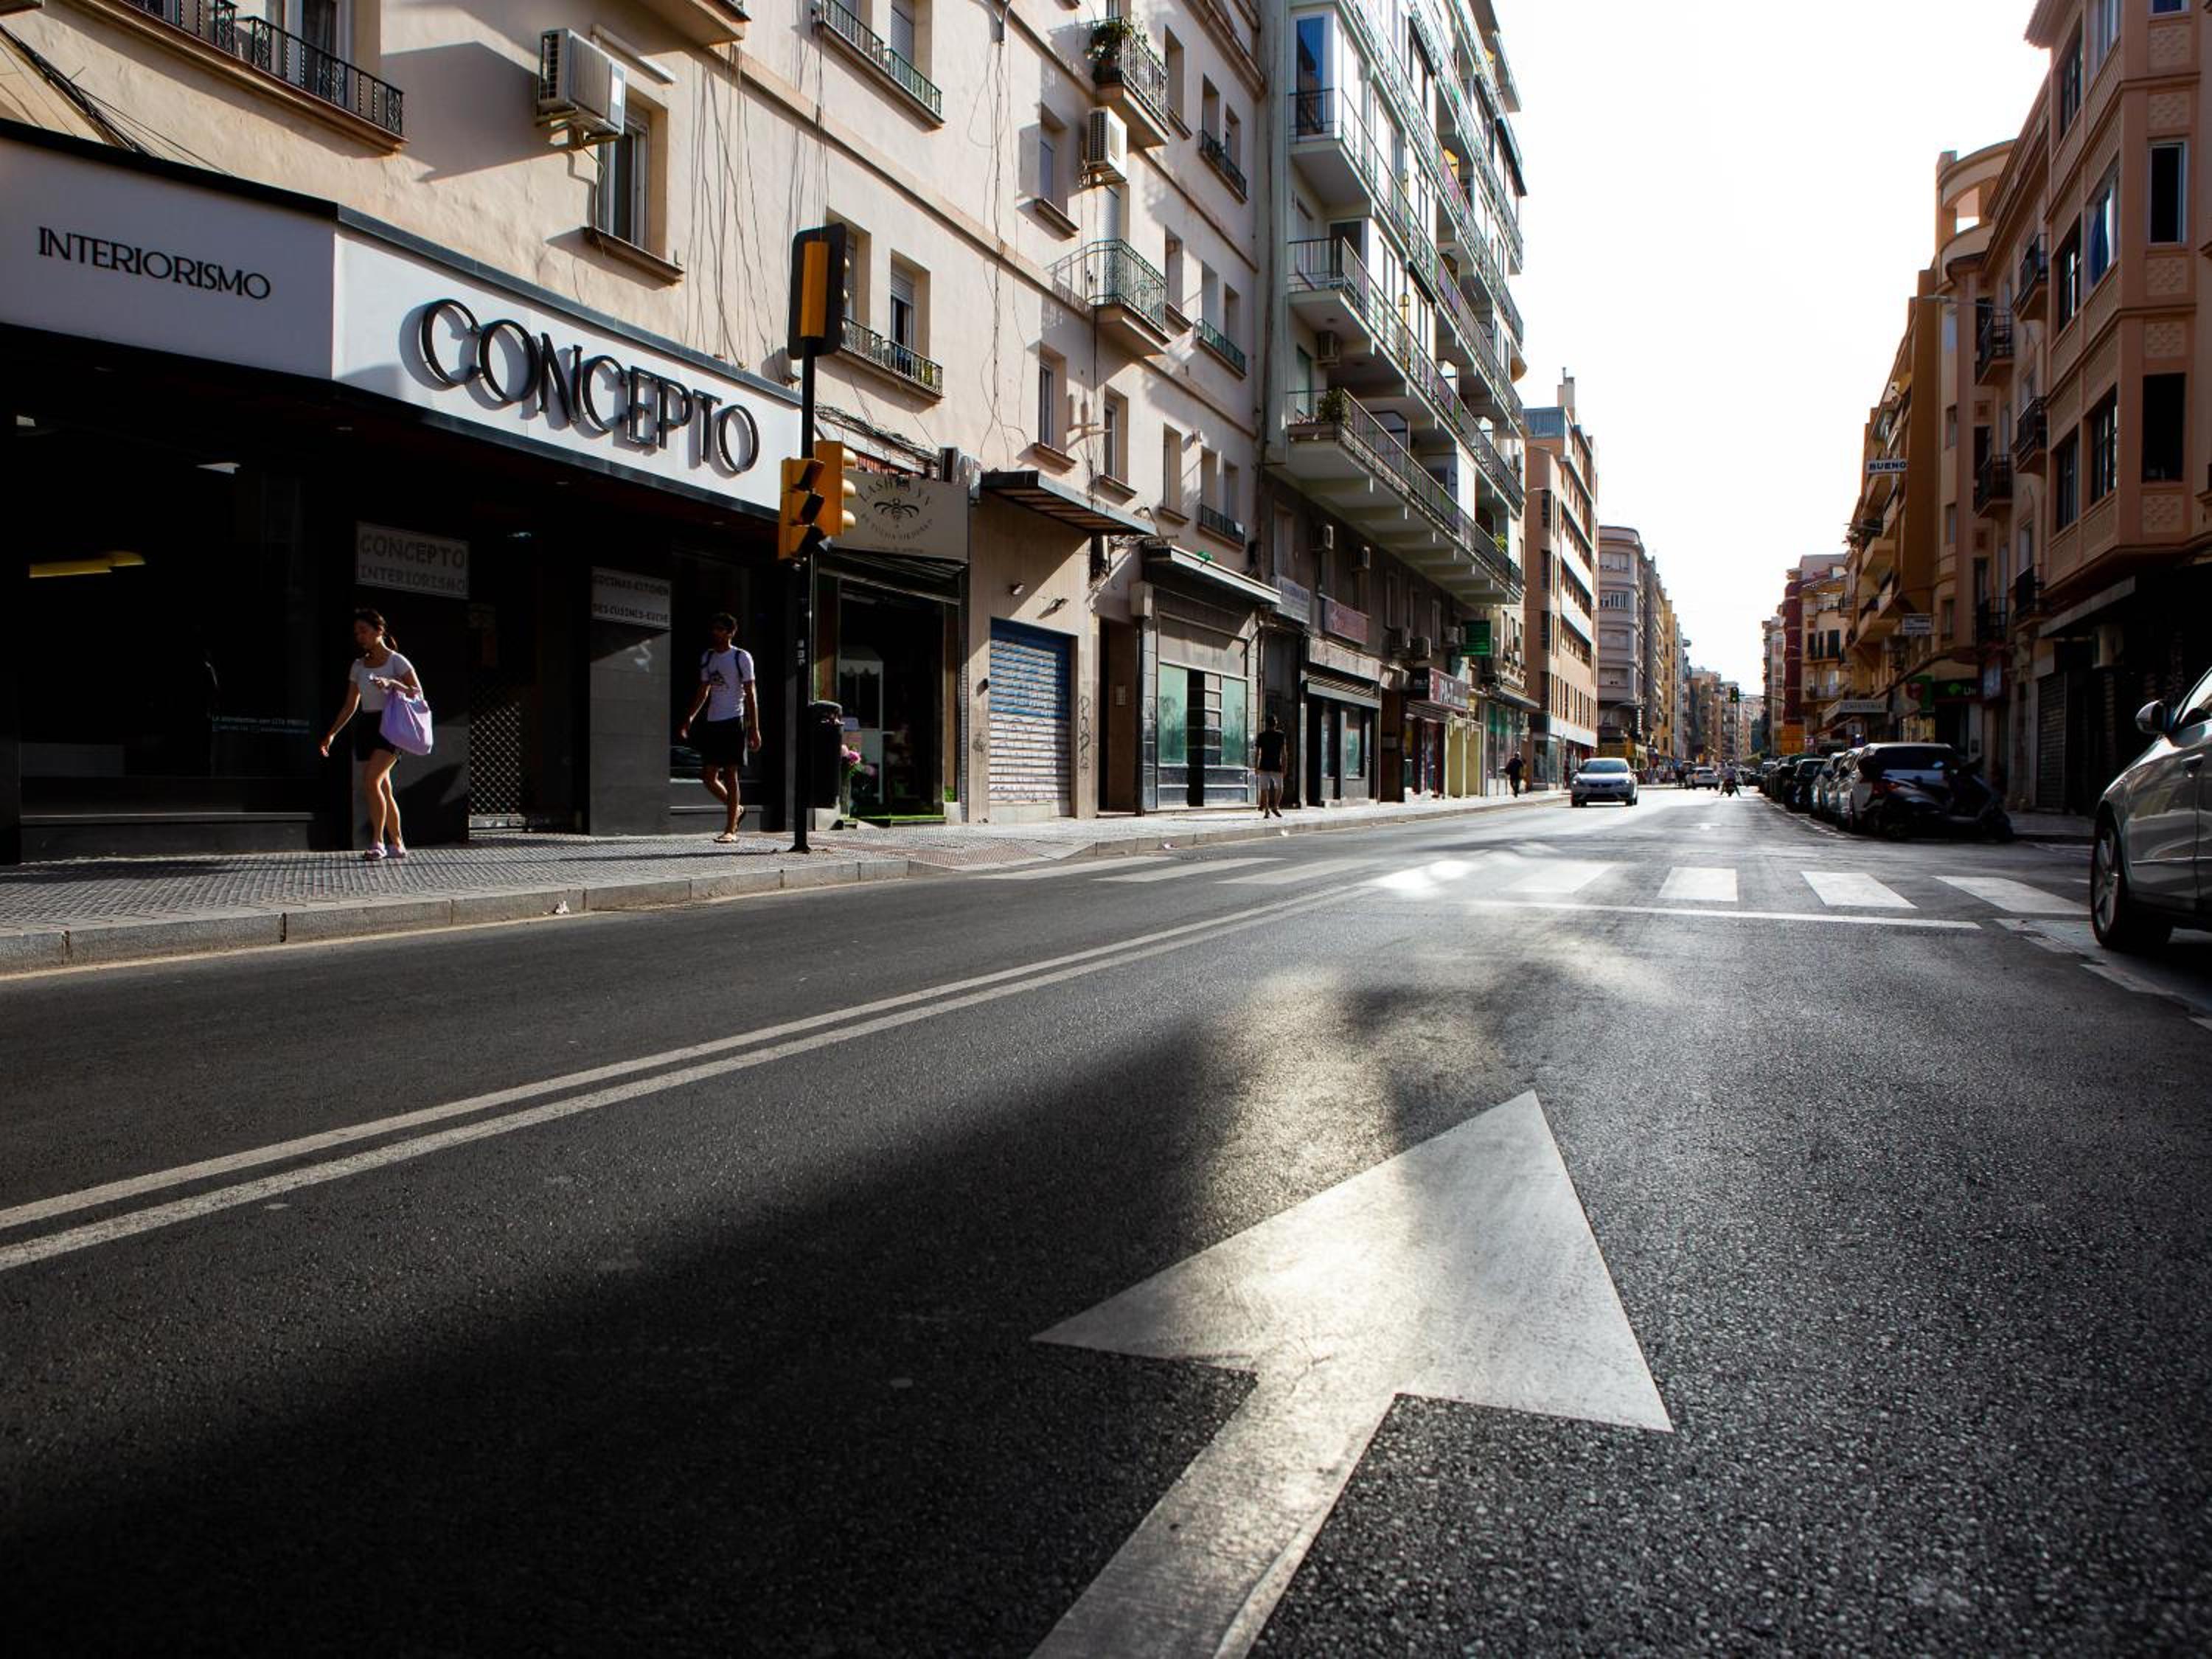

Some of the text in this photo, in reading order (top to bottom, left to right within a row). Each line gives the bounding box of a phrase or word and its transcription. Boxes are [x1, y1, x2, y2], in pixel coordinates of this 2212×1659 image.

[38, 226, 271, 299] INTERIORISMO
[420, 298, 759, 473] CONCEPTO
[1869, 461, 1907, 470] BUENO
[359, 533, 465, 568] CONCEPTO
[359, 565, 466, 593] INTERIORISMO
